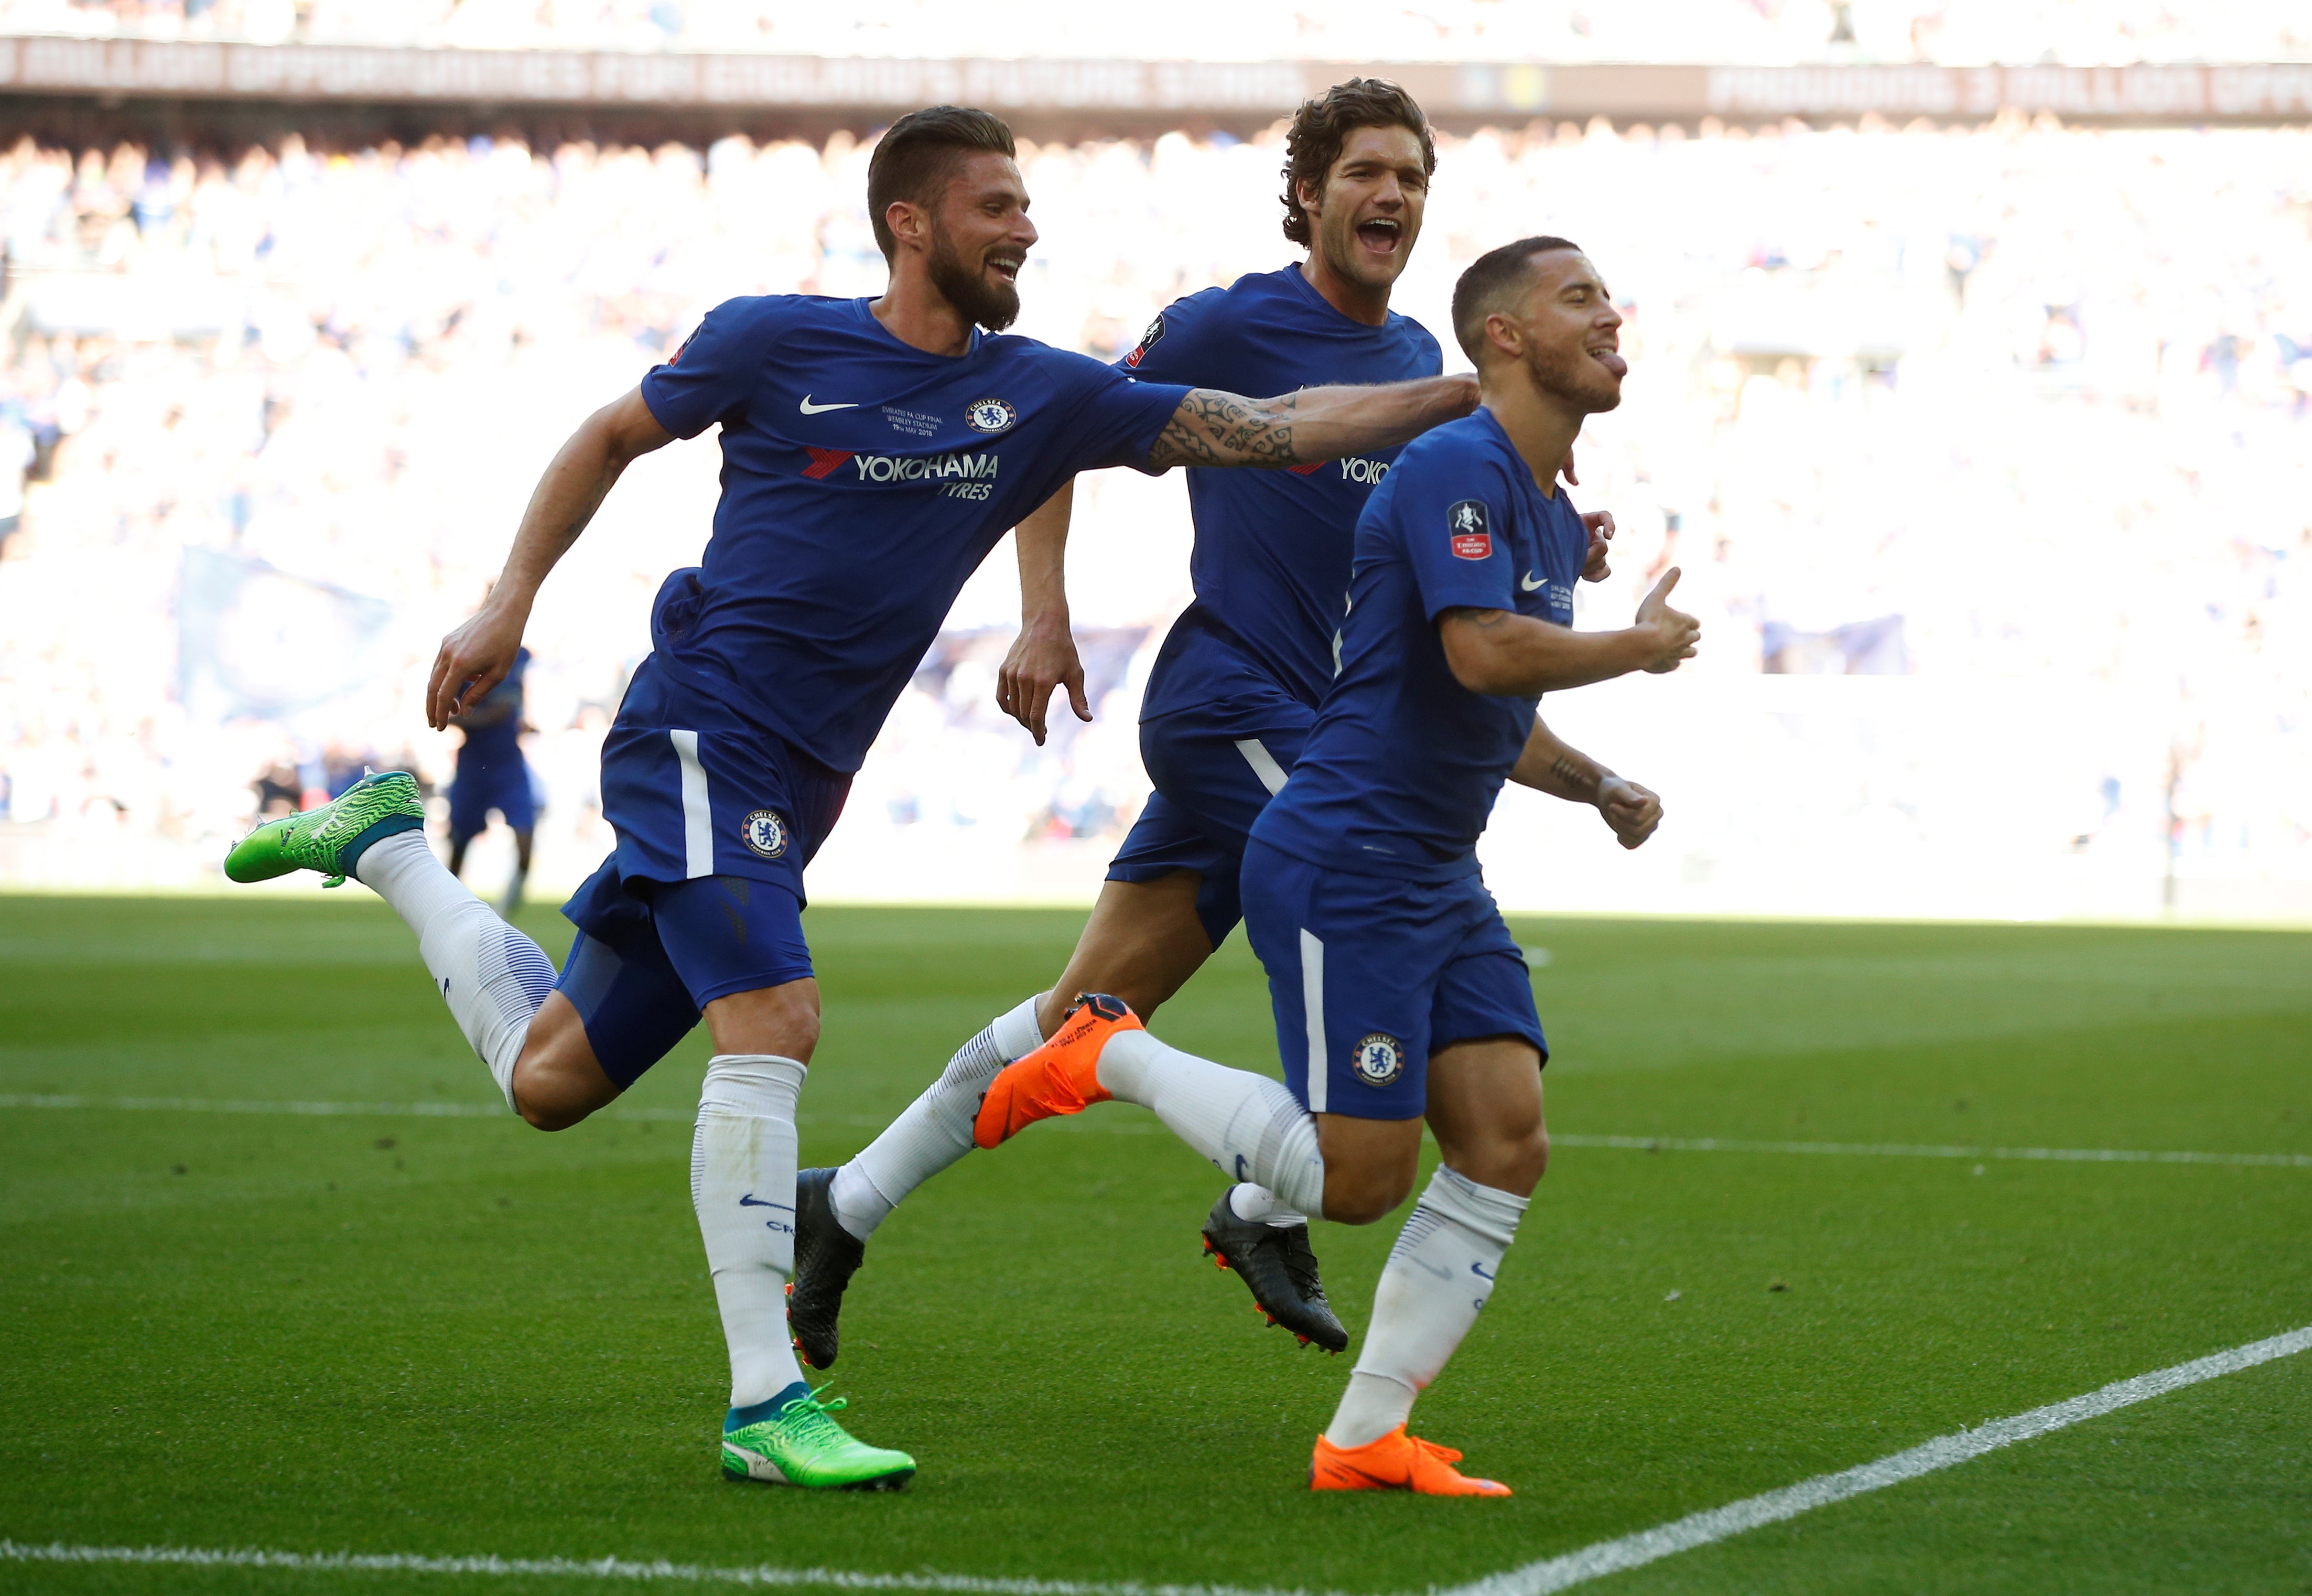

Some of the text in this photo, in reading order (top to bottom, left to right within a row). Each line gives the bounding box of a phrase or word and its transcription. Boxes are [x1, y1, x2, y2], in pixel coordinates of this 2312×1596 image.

[970, 400, 1001, 412] CHELSEA
[882, 406, 906, 417] EMIRATES
[927, 415, 943, 424] FINAL
[887, 415, 937, 430] WEMBLEY STADIUM
[919, 428, 933, 437] 2018
[854, 454, 999, 481] YOKOHAMA
[937, 482, 993, 501] TYRES
[750, 812, 780, 825] CHELSEA
[1076, 1031, 1086, 1040] CUP
[1061, 1038, 1075, 1048] FINAL
[1362, 1036, 1395, 1048] CHELSEA
